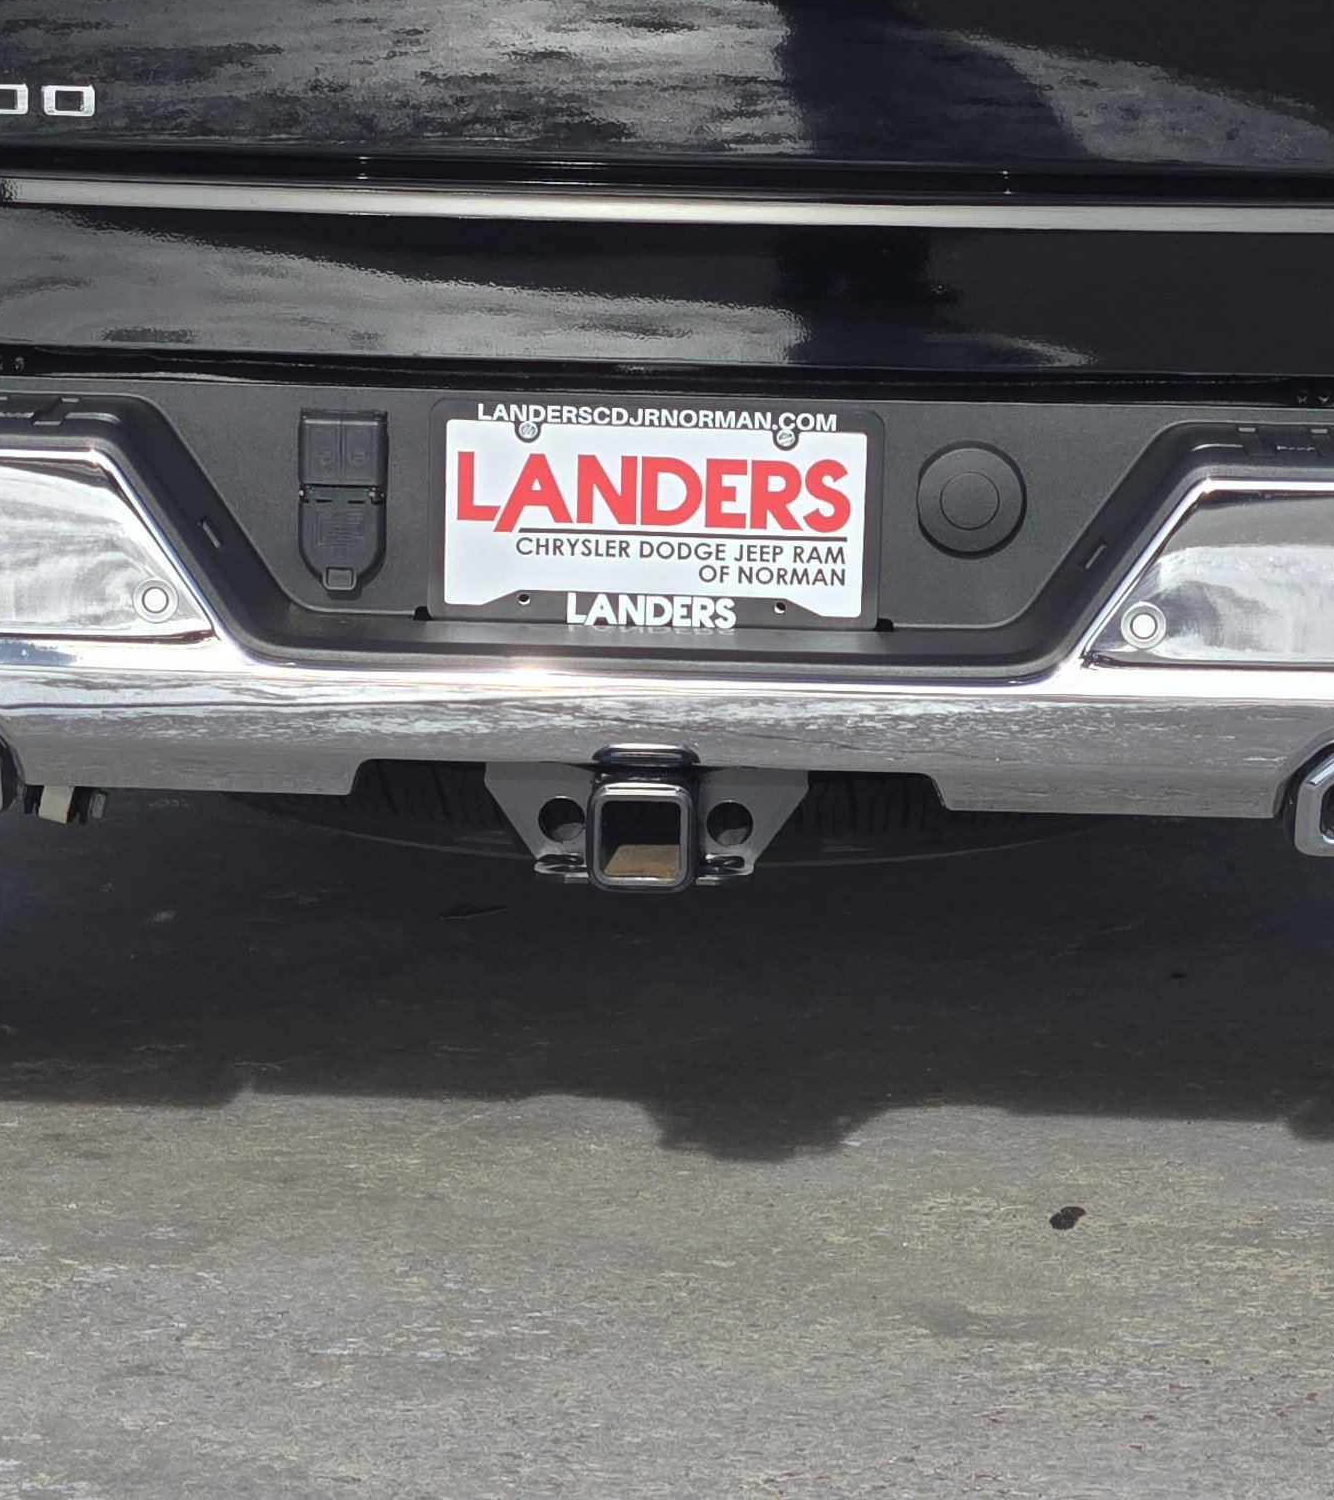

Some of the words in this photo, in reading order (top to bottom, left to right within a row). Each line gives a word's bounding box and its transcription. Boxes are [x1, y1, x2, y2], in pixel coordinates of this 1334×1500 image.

[478, 403, 837, 432] LANDERSCDJRNORMAN.COM
[457, 450, 851, 533] LANDERS
[515, 536, 631, 560] CHRYSLER
[639, 542, 726, 562] DODGE
[733, 545, 785, 564] JEEP
[793, 546, 846, 565] RAM
[698, 565, 731, 584] OF
[737, 566, 846, 586] NORMAN
[567, 592, 737, 629] LANDERS
